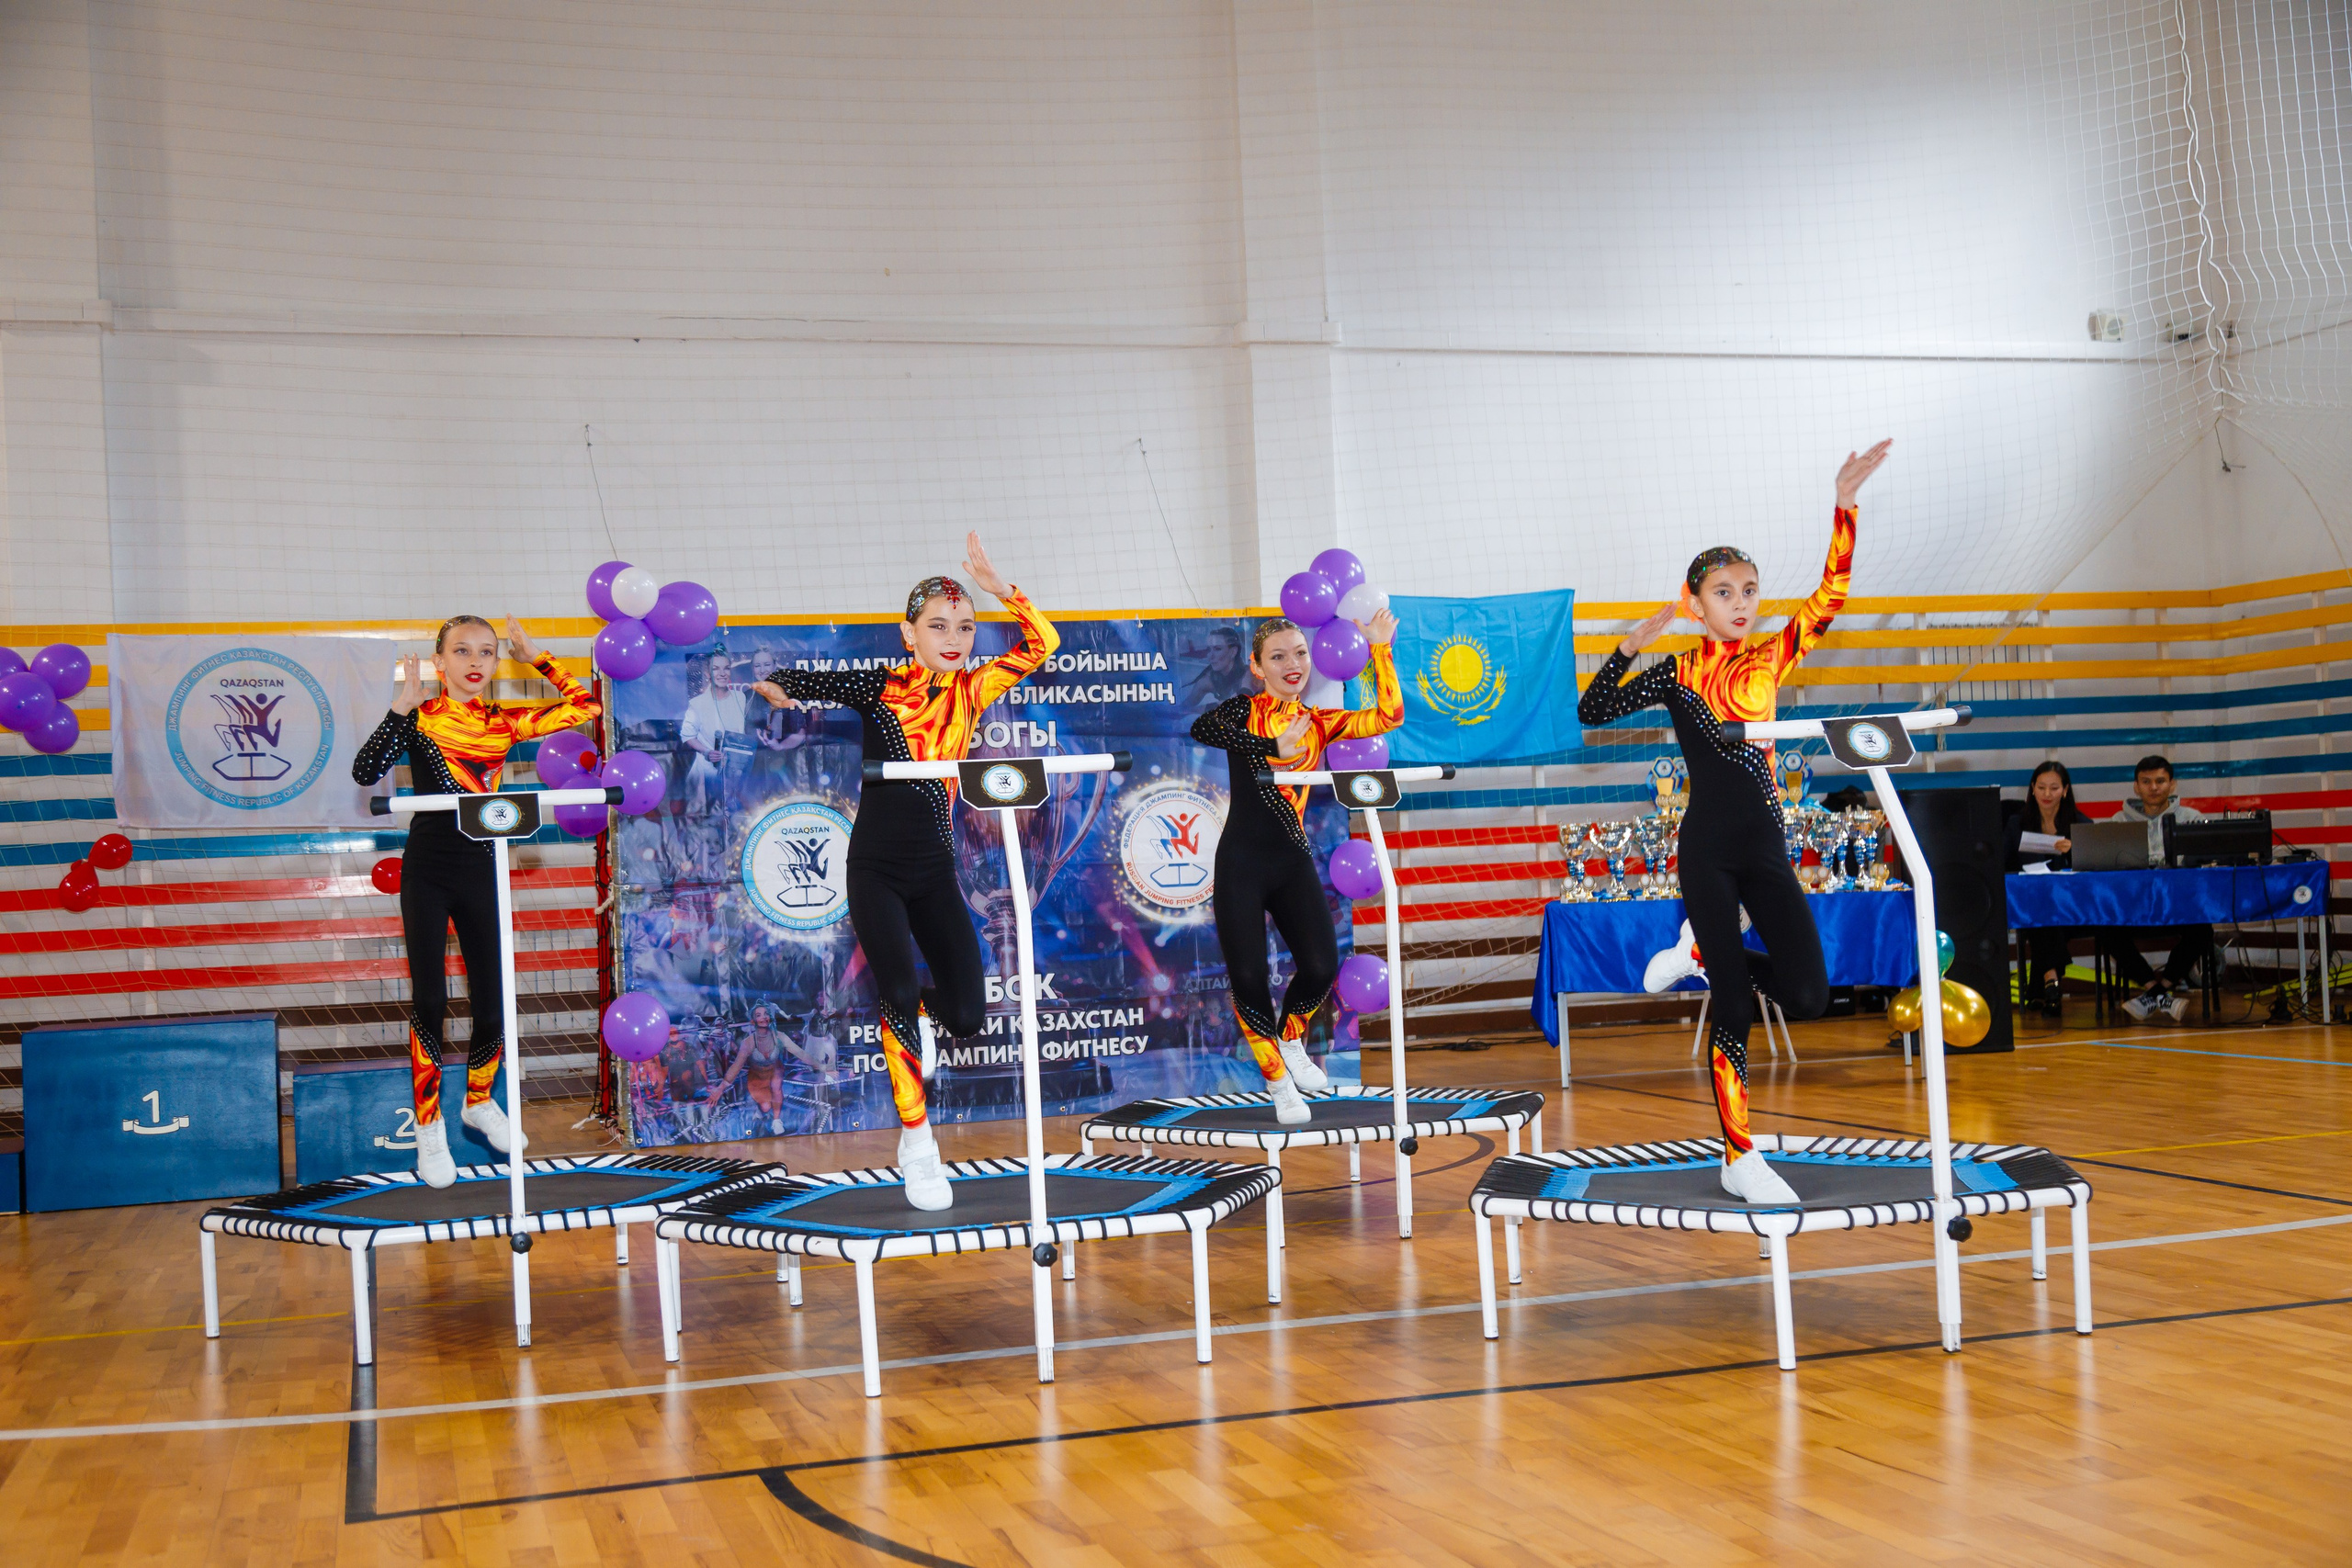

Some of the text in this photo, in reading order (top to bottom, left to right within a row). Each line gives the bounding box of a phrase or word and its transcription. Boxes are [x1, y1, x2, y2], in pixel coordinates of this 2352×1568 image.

[1046, 650, 1168, 672] БОЙЫНША
[169, 679, 192, 731] ДЖАМПИНГ
[191, 654, 228, 679] ФИТНЕС
[287, 661, 332, 730] РЕСПУБЛИКАСЫ
[220, 679, 284, 688] QAZAQSTAN
[992, 682, 1176, 705] УБЛИКАСЫНЫҢ
[968, 720, 1057, 749] БОГЫ
[175, 744, 329, 807] JUMPING FITNESS REPUBLIC OF KAZAKSTAN
[781, 827, 830, 835] QAZAQSTAN
[1123, 793, 1217, 850] ФЕДЕРАЦИЯ ДЖАМПИНГ ФИТНЕСА
[745, 828, 763, 871] ДЖАМПИНГ
[763, 809, 790, 829] ФИТНЕС
[1125, 862, 1204, 906] RUSSIAN JUMPING FITNESS
[750, 888, 837, 927] JUMPING FITNESS REPUBLIC OF
[985, 974, 1057, 1003] БОК
[854, 1034, 1149, 1074] ПО АМПИН ФИТНЕСУ
[142, 1090, 160, 1123] 1
[395, 1107, 415, 1137] 2
